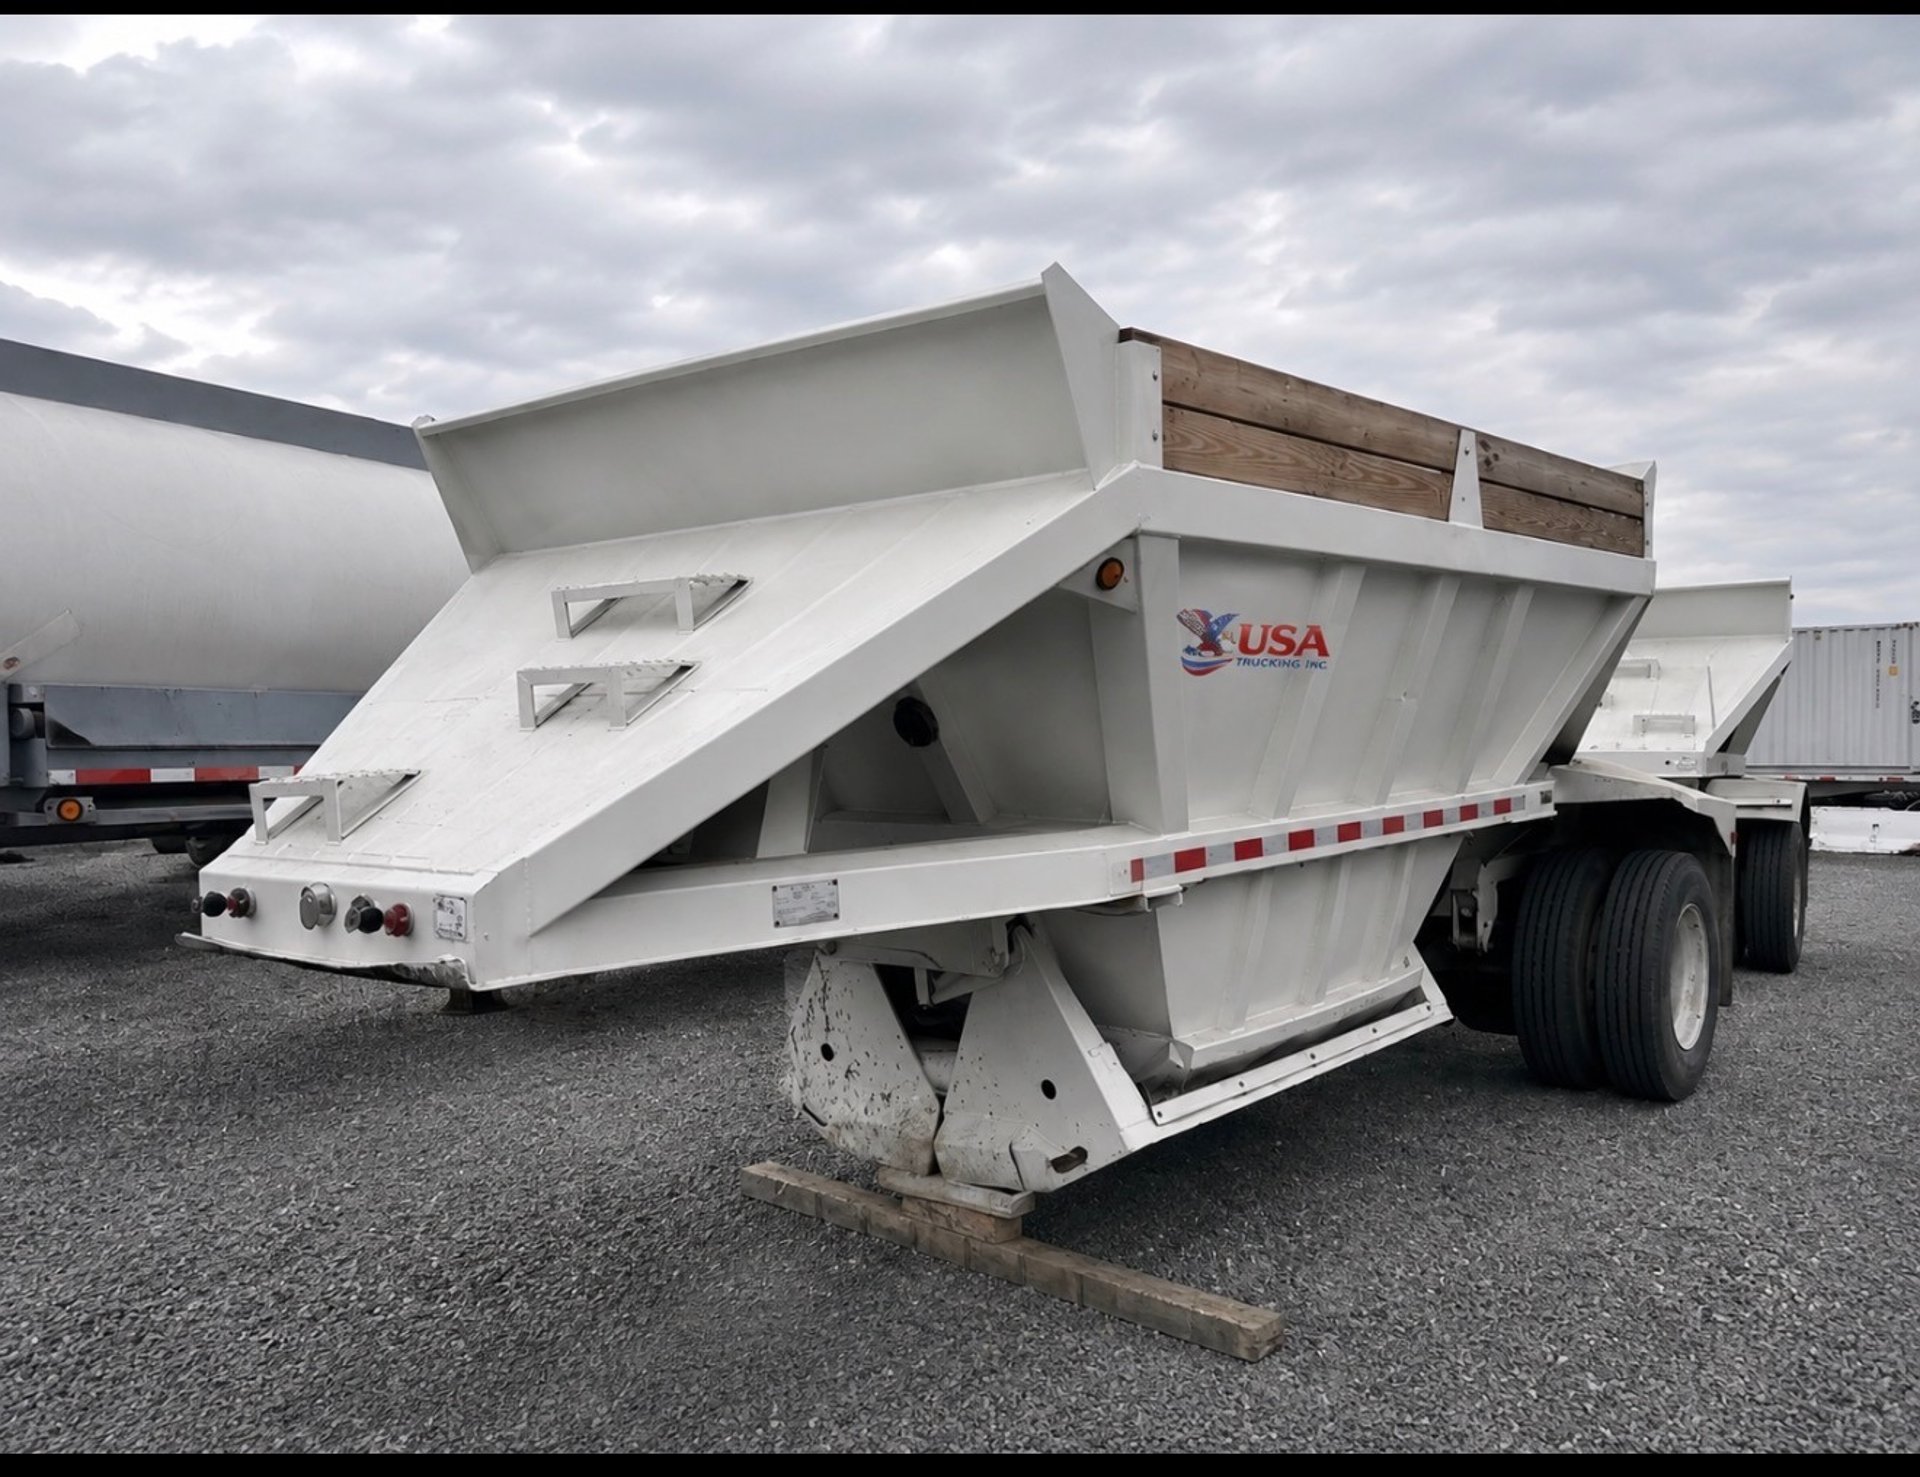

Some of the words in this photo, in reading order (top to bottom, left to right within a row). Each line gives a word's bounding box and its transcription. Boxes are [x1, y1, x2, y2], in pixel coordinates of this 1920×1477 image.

[1238, 623, 1330, 657] USA
[1236, 657, 1300, 668] TRUCKING
[1305, 659, 1328, 670] INC
